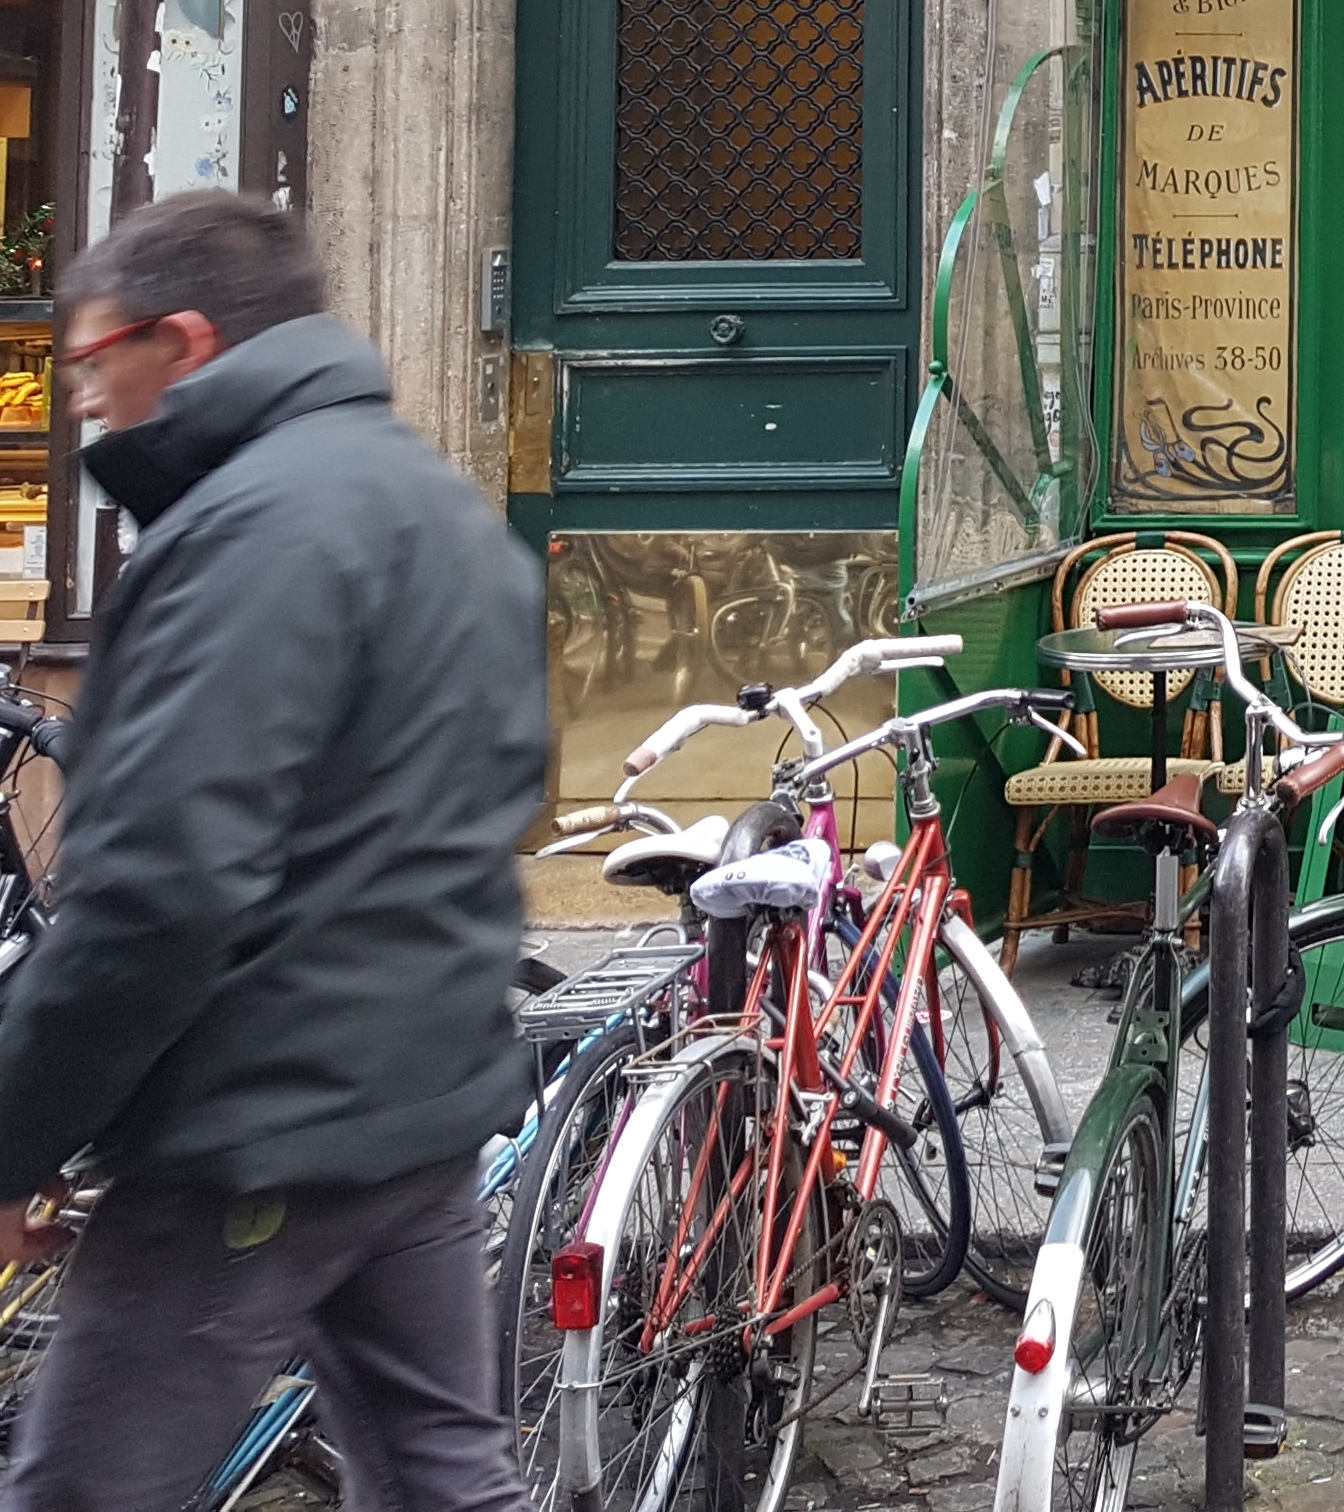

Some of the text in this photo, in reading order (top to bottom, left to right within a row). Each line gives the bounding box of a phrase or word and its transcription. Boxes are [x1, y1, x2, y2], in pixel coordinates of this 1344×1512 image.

[1135, 49, 1288, 109] APÉRITIFS
[1186, 124, 1225, 142] DE
[1135, 159, 1282, 200] MARQUES
[1132, 230, 1284, 271] TÉLÉPHONE
[1131, 290, 1282, 321] Paris-Province
[1213, 345, 1282, 372] 38-50
